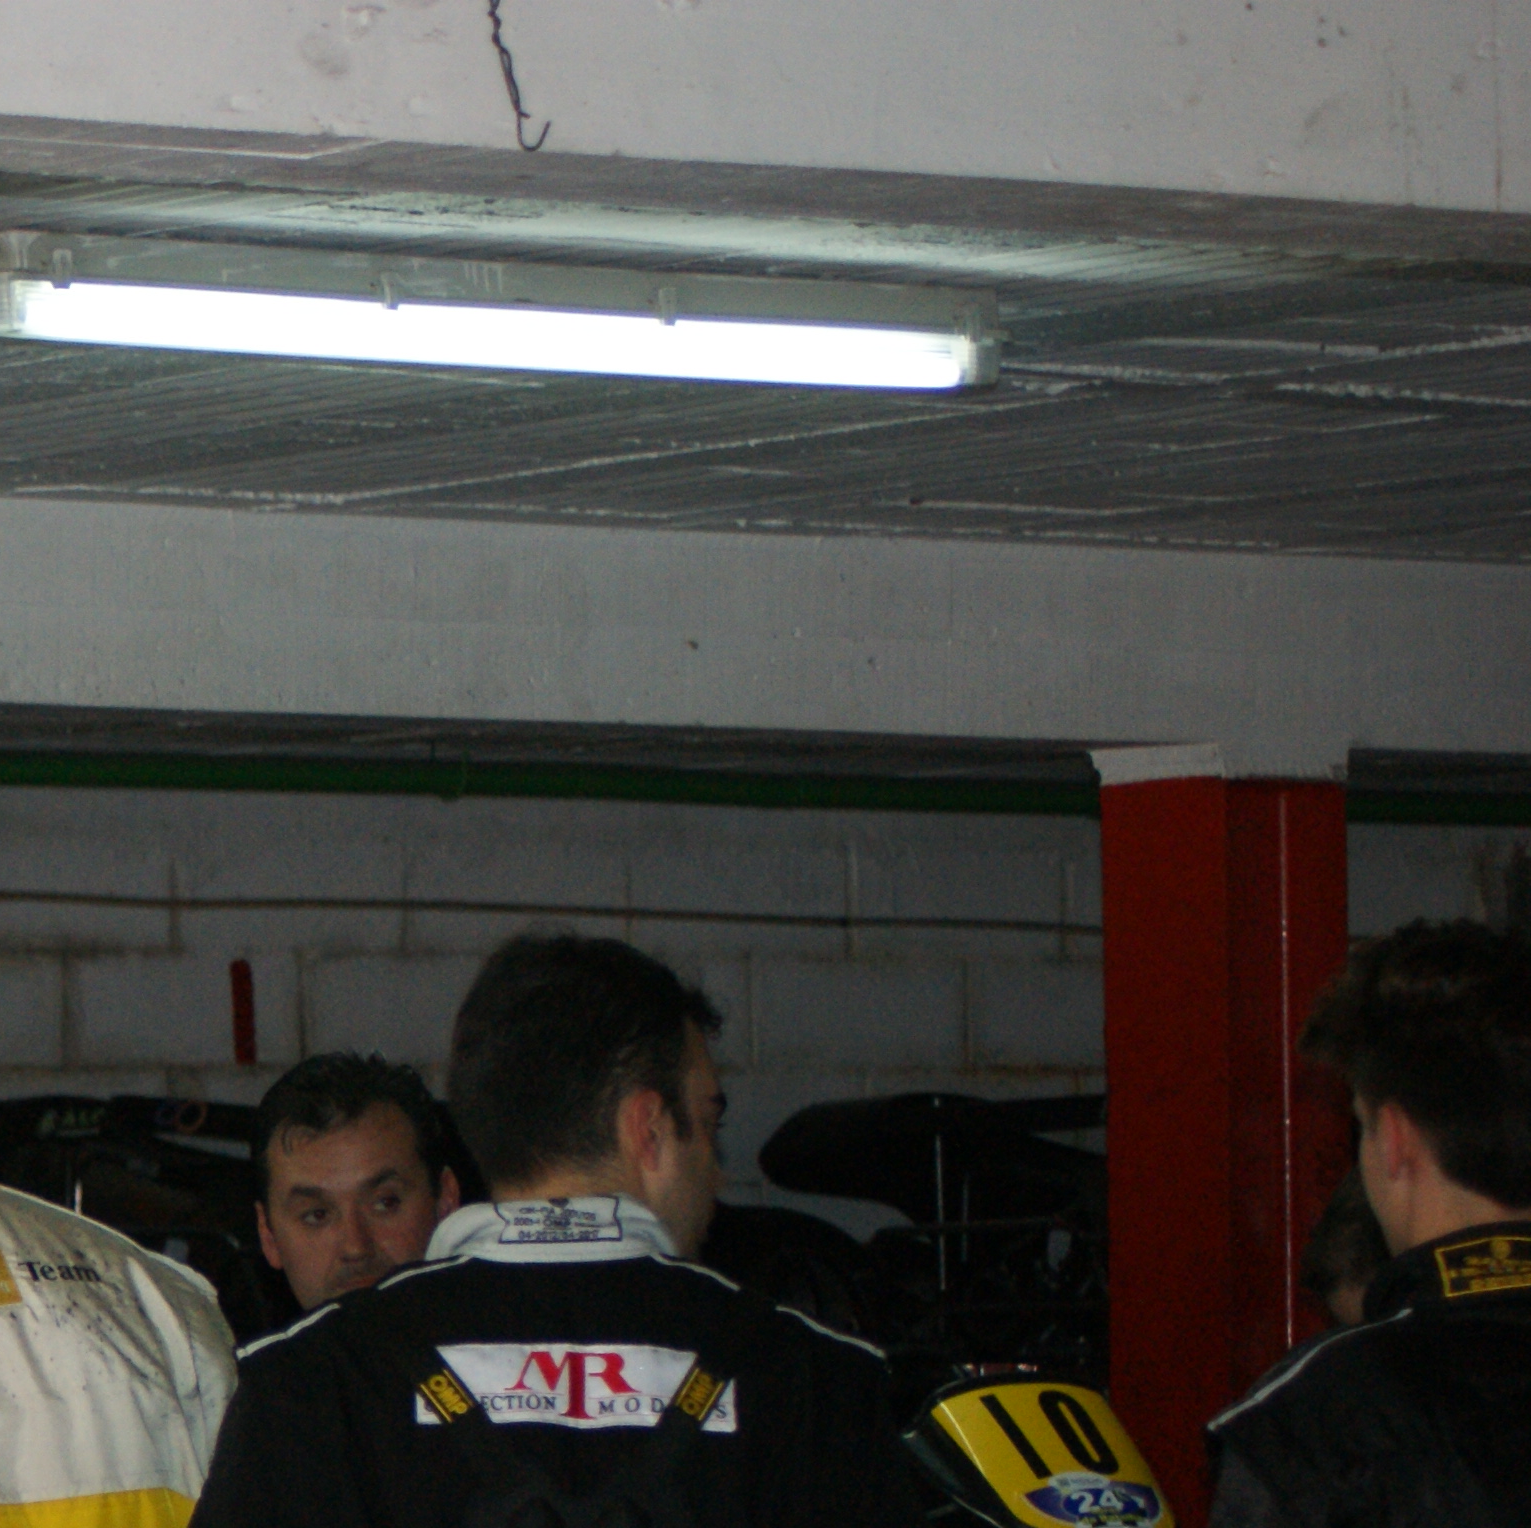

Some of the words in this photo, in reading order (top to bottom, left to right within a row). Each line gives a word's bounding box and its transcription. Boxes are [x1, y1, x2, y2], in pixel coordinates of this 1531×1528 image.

[18, 1261, 100, 1283] Team
[427, 1374, 469, 1415] OMP
[980, 1391, 1119, 1479] 10
